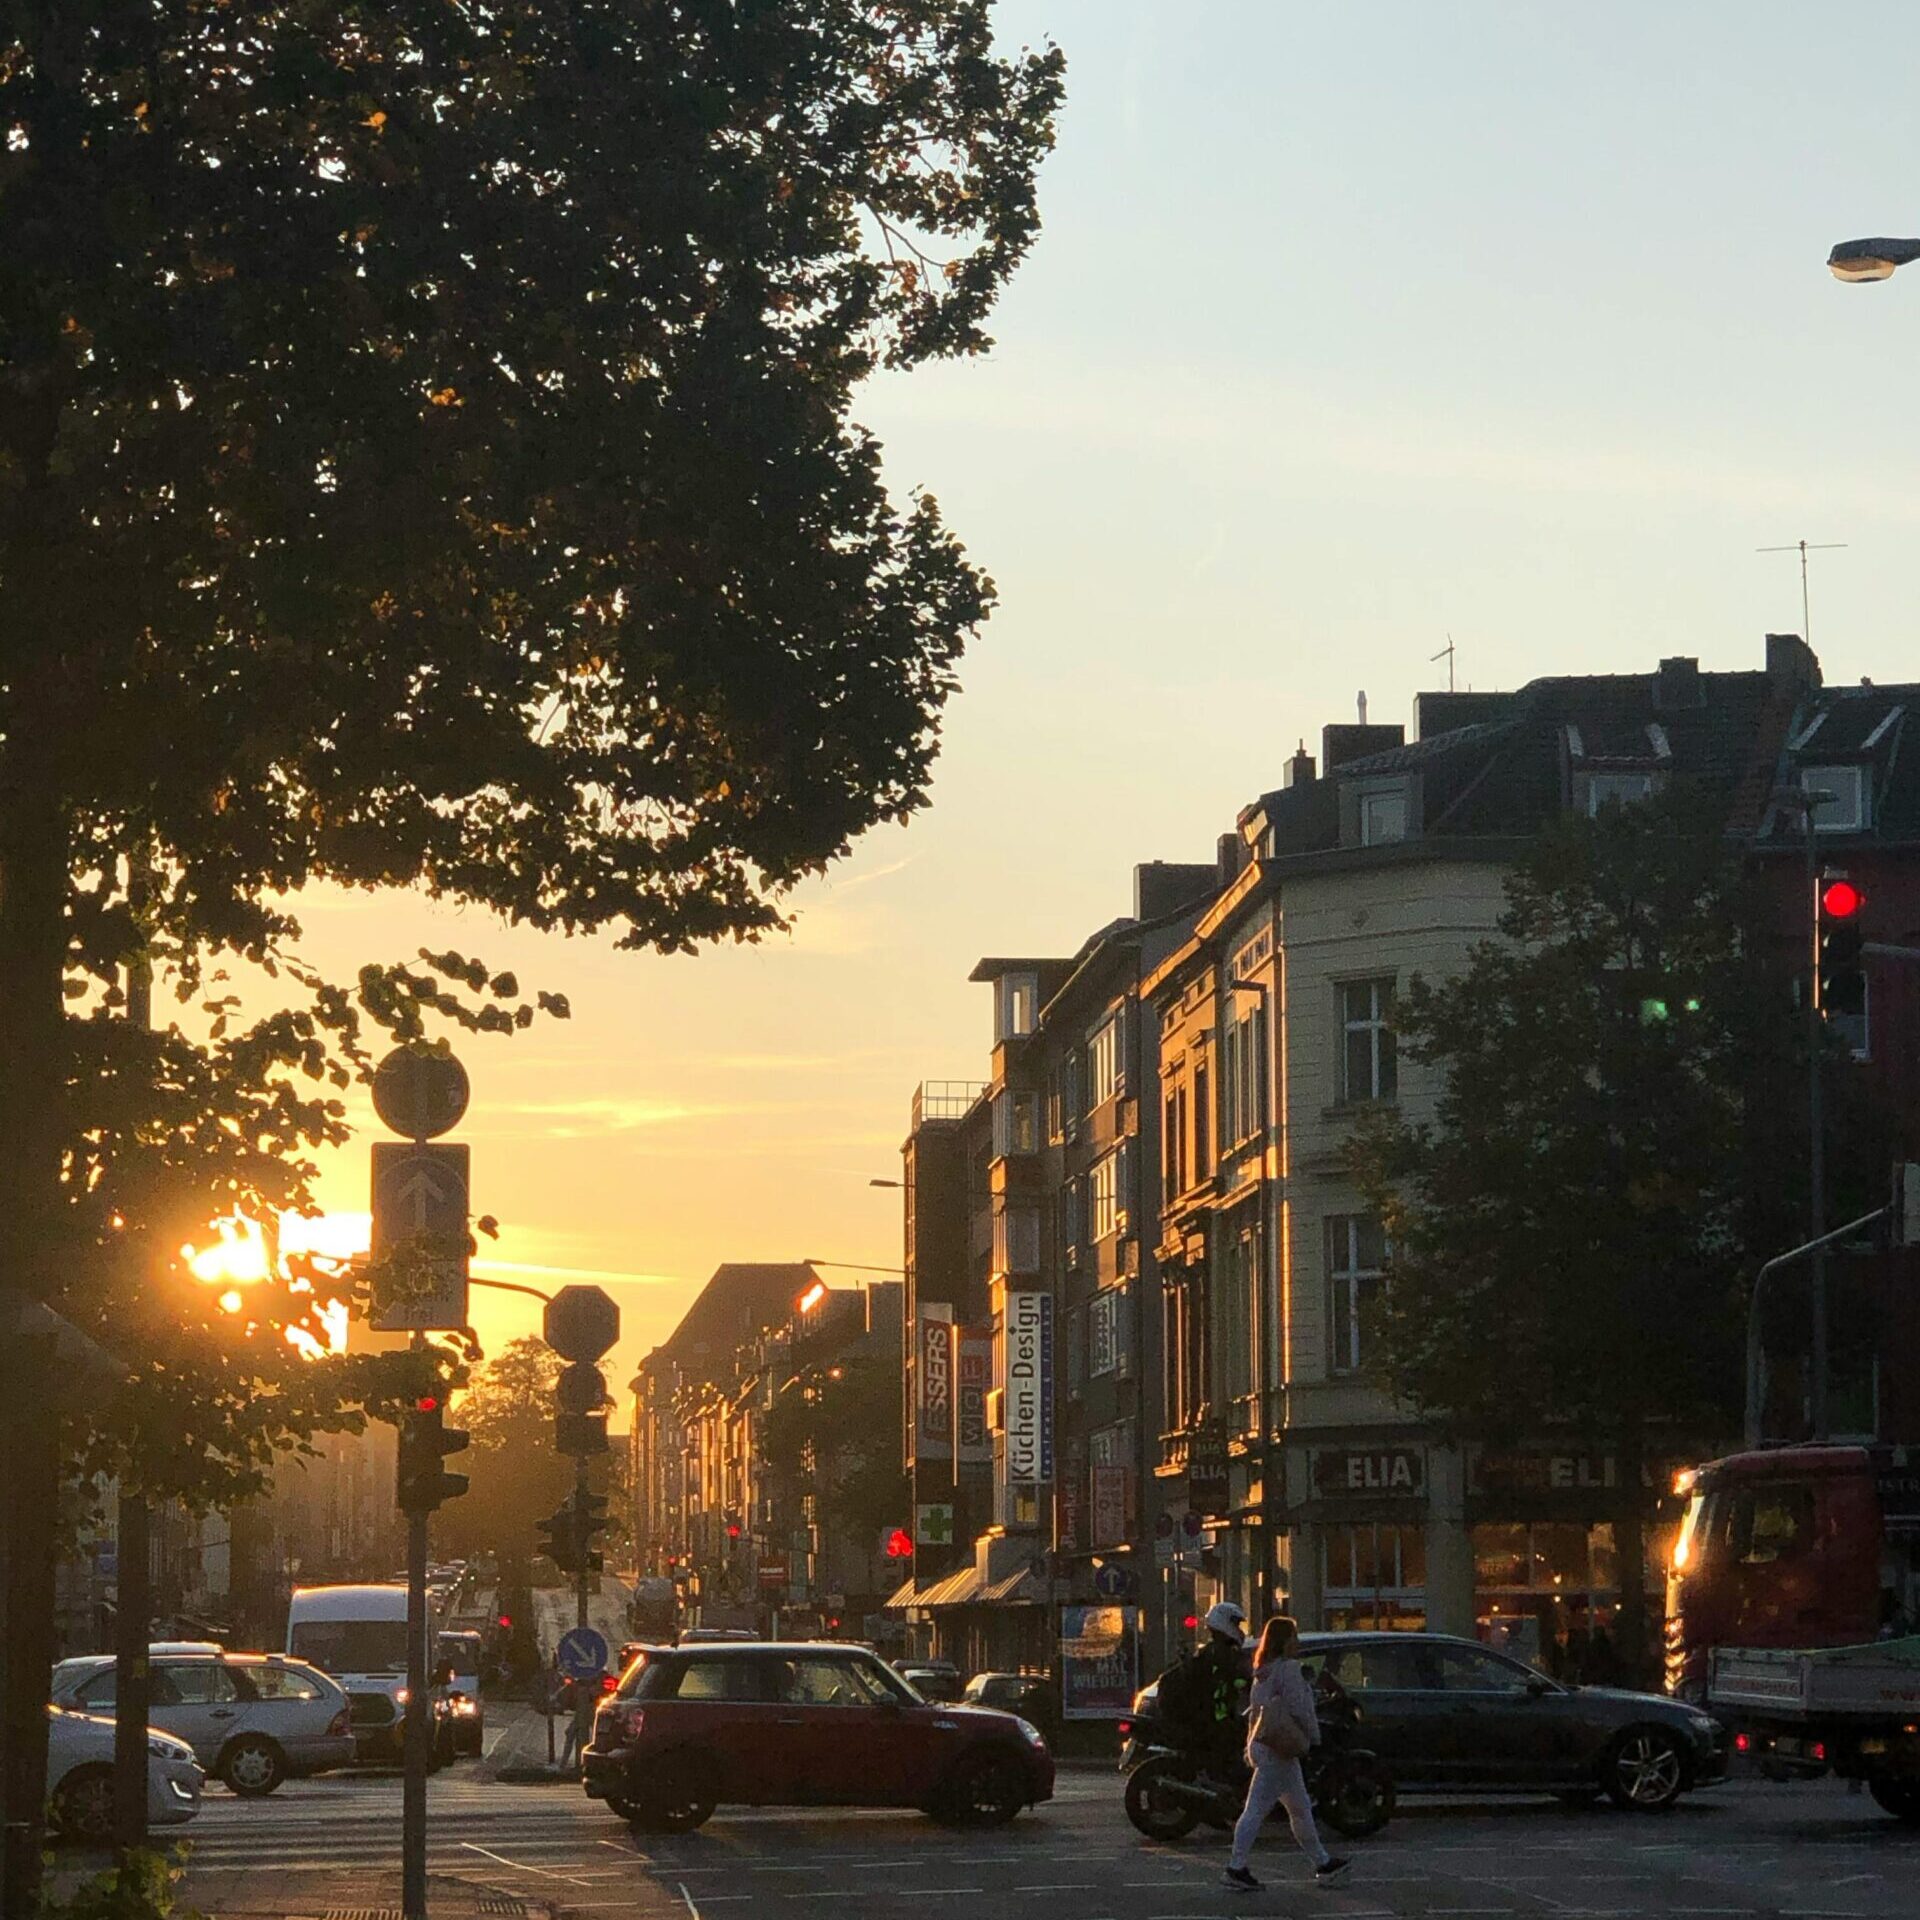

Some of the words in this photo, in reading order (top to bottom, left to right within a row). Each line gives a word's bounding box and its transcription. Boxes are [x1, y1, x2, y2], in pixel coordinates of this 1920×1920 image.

[927, 1328, 947, 1432] ESSERS
[1009, 1296, 1039, 1481] Küchen-Design
[1191, 1465, 1227, 1479] ELIA
[1347, 1456, 1412, 1487] ELIA
[1072, 1674, 1128, 1688] WIEDER
